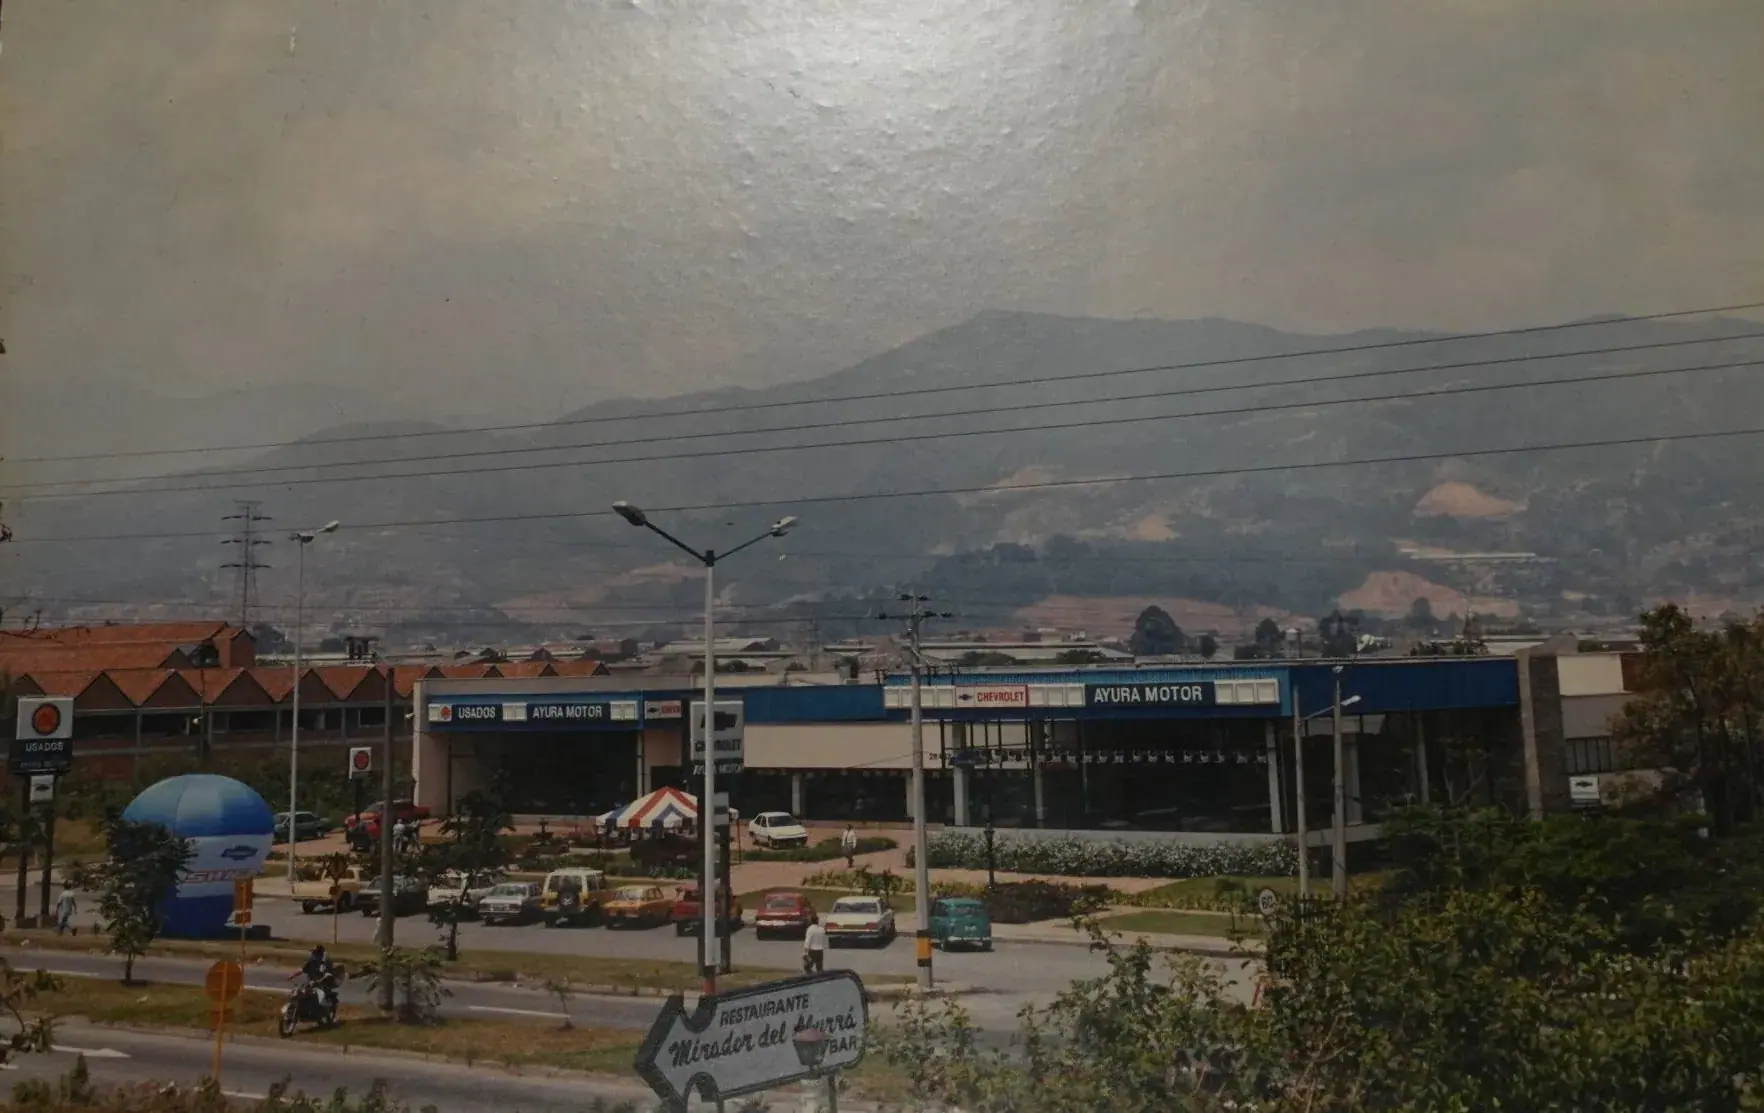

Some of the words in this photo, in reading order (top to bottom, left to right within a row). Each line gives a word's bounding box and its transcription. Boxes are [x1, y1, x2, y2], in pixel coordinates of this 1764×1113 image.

[977, 690, 1025, 703] CHEVROLET
[1094, 687, 1140, 703] AYURA
[1145, 686, 1202, 702] MOTOR
[458, 705, 496, 719] USADOS
[533, 705, 564, 719] AYURA
[566, 704, 603, 718] MOTOR
[25, 741, 64, 753] USADOS
[720, 993, 809, 1027] RESTAURANTE
[668, 1030, 755, 1068] Mirador
[758, 1022, 788, 1048] del
[828, 1035, 857, 1056] BAR
